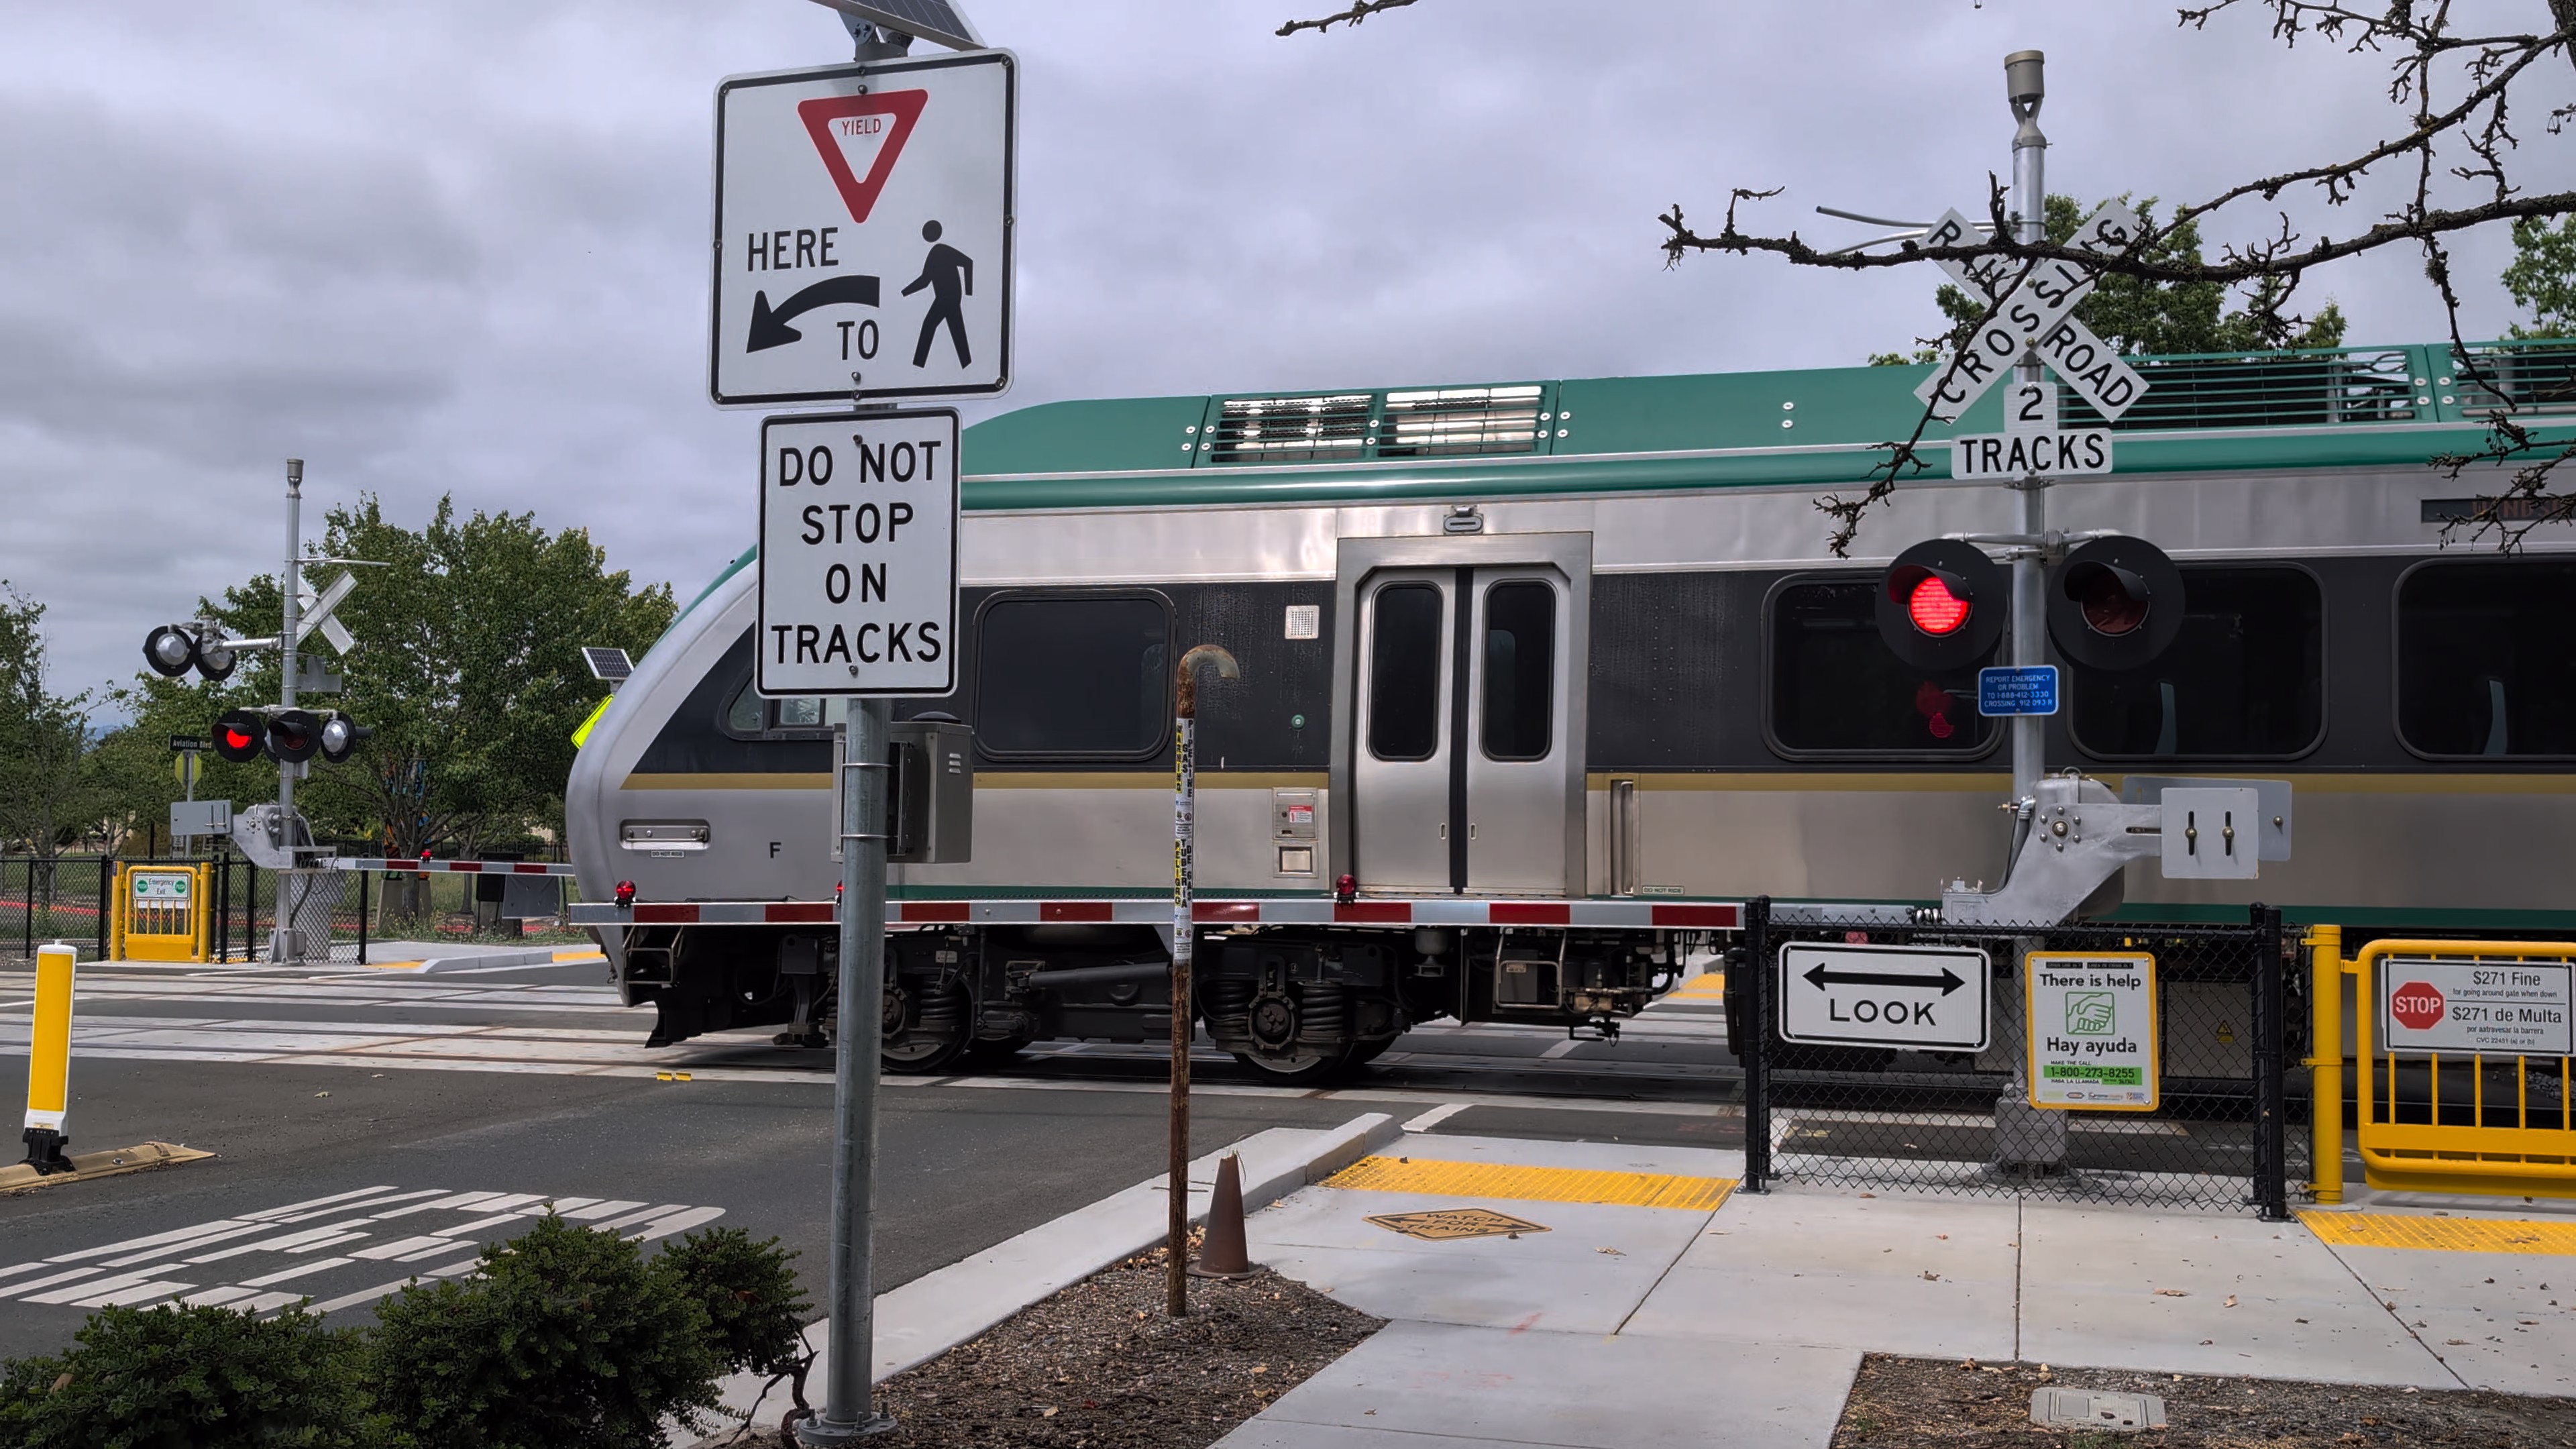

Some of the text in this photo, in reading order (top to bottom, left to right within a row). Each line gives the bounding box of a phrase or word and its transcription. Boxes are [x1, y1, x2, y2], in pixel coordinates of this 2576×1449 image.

[841, 118, 881, 136] YIELD
[748, 227, 839, 272] HERE
[837, 319, 879, 360] TO
[2043, 323, 2133, 408] ROAD
[2019, 387, 2043, 421] 2
[1960, 433, 2104, 474] TRACKS
[780, 441, 942, 487] DO NOT
[801, 502, 914, 545] STOP
[826, 563, 886, 604] ON
[771, 621, 942, 664] TRACKS
[172, 739, 212, 749] Aviation Blvd
[769, 842, 781, 859] F
[149, 878, 174, 886] Emergency
[2039, 973, 2141, 990] There is help
[2473, 971, 2540, 986] $271 Fine
[2463, 989, 2480, 997] going
[1829, 998, 1936, 1026] LOOK
[2396, 997, 2440, 1014] STOP
[2452, 1006, 2561, 1023] $271 de Multa
[2521, 1026, 2544, 1034] barrera
[2047, 1037, 2137, 1057] Hay ayuda
[2051, 1067, 2135, 1078] 1-800-273-8255
[1407, 1224, 1489, 1232] TRAINS
